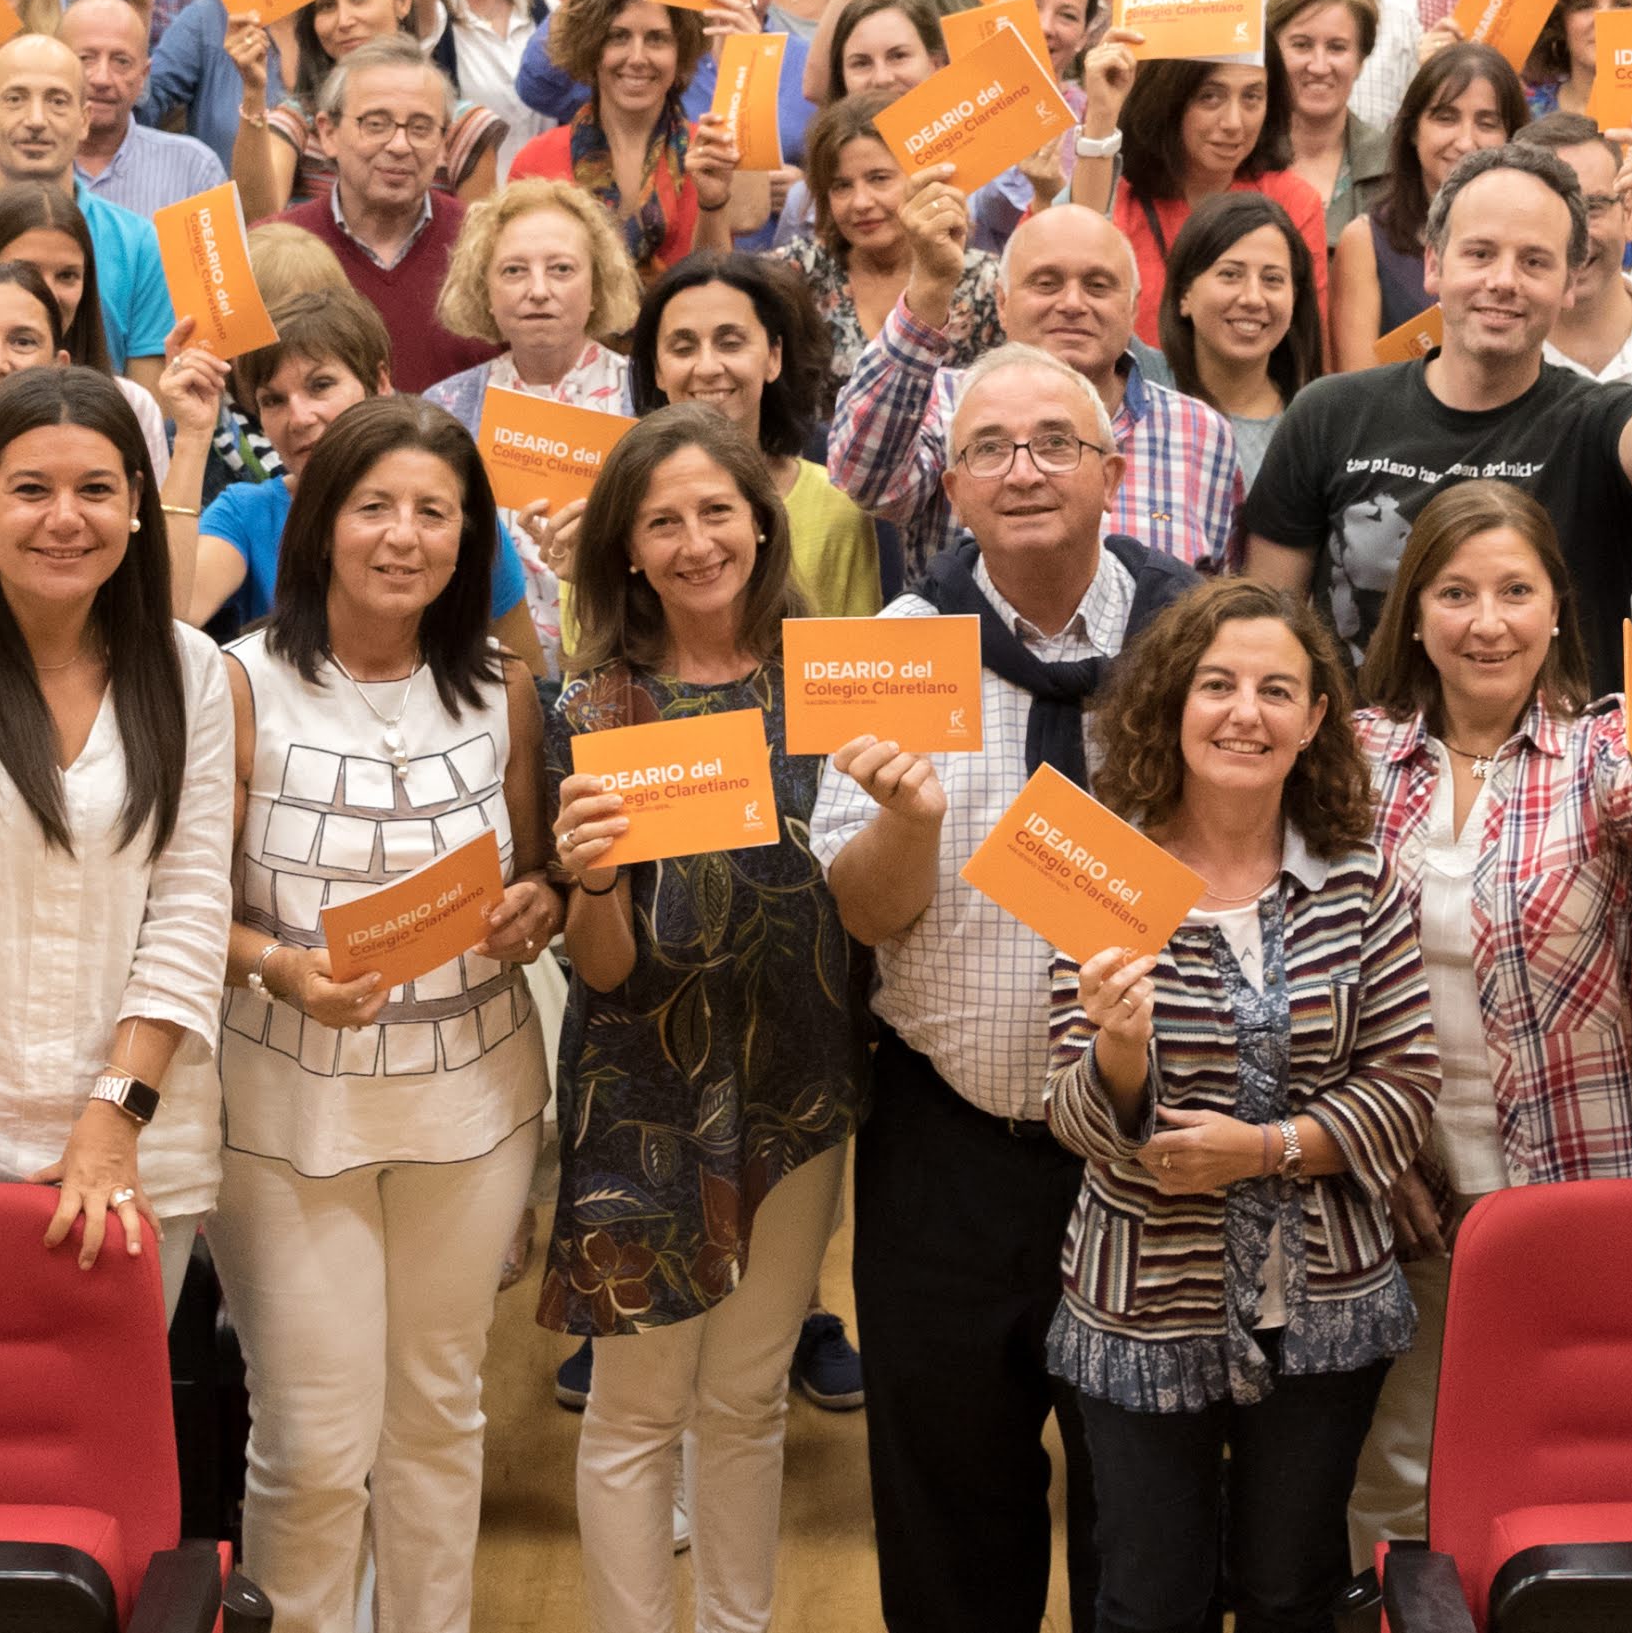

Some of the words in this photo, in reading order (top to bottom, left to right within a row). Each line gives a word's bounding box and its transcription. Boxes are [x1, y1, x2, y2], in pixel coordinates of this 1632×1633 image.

[902, 101, 974, 155] IDEARIO
[977, 79, 1005, 106] del
[914, 130, 963, 165] Colegio
[964, 85, 1030, 132] Claretiano
[491, 444, 542, 468] Colegio
[494, 426, 569, 459] IDEARIO
[572, 446, 602, 466] del
[1346, 458, 1369, 473] the
[1370, 457, 1416, 478] piano
[804, 661, 894, 680] IDEARIO
[899, 660, 933, 679] del
[804, 681, 867, 699] Colegio
[872, 680, 958, 696] Claretiano
[600, 763, 684, 793] DEARIO
[691, 757, 723, 778] del
[662, 775, 750, 800] Claretiano
[1022, 812, 1107, 880] IDEARIO
[1107, 878, 1144, 908] del
[1014, 831, 1070, 878] Colegio
[1072, 874, 1148, 936] Claretiano
[347, 902, 432, 946] IDEARIO
[436, 882, 464, 910] del
[349, 929, 410, 959] Colegio
[413, 886, 485, 934] Claretiano
